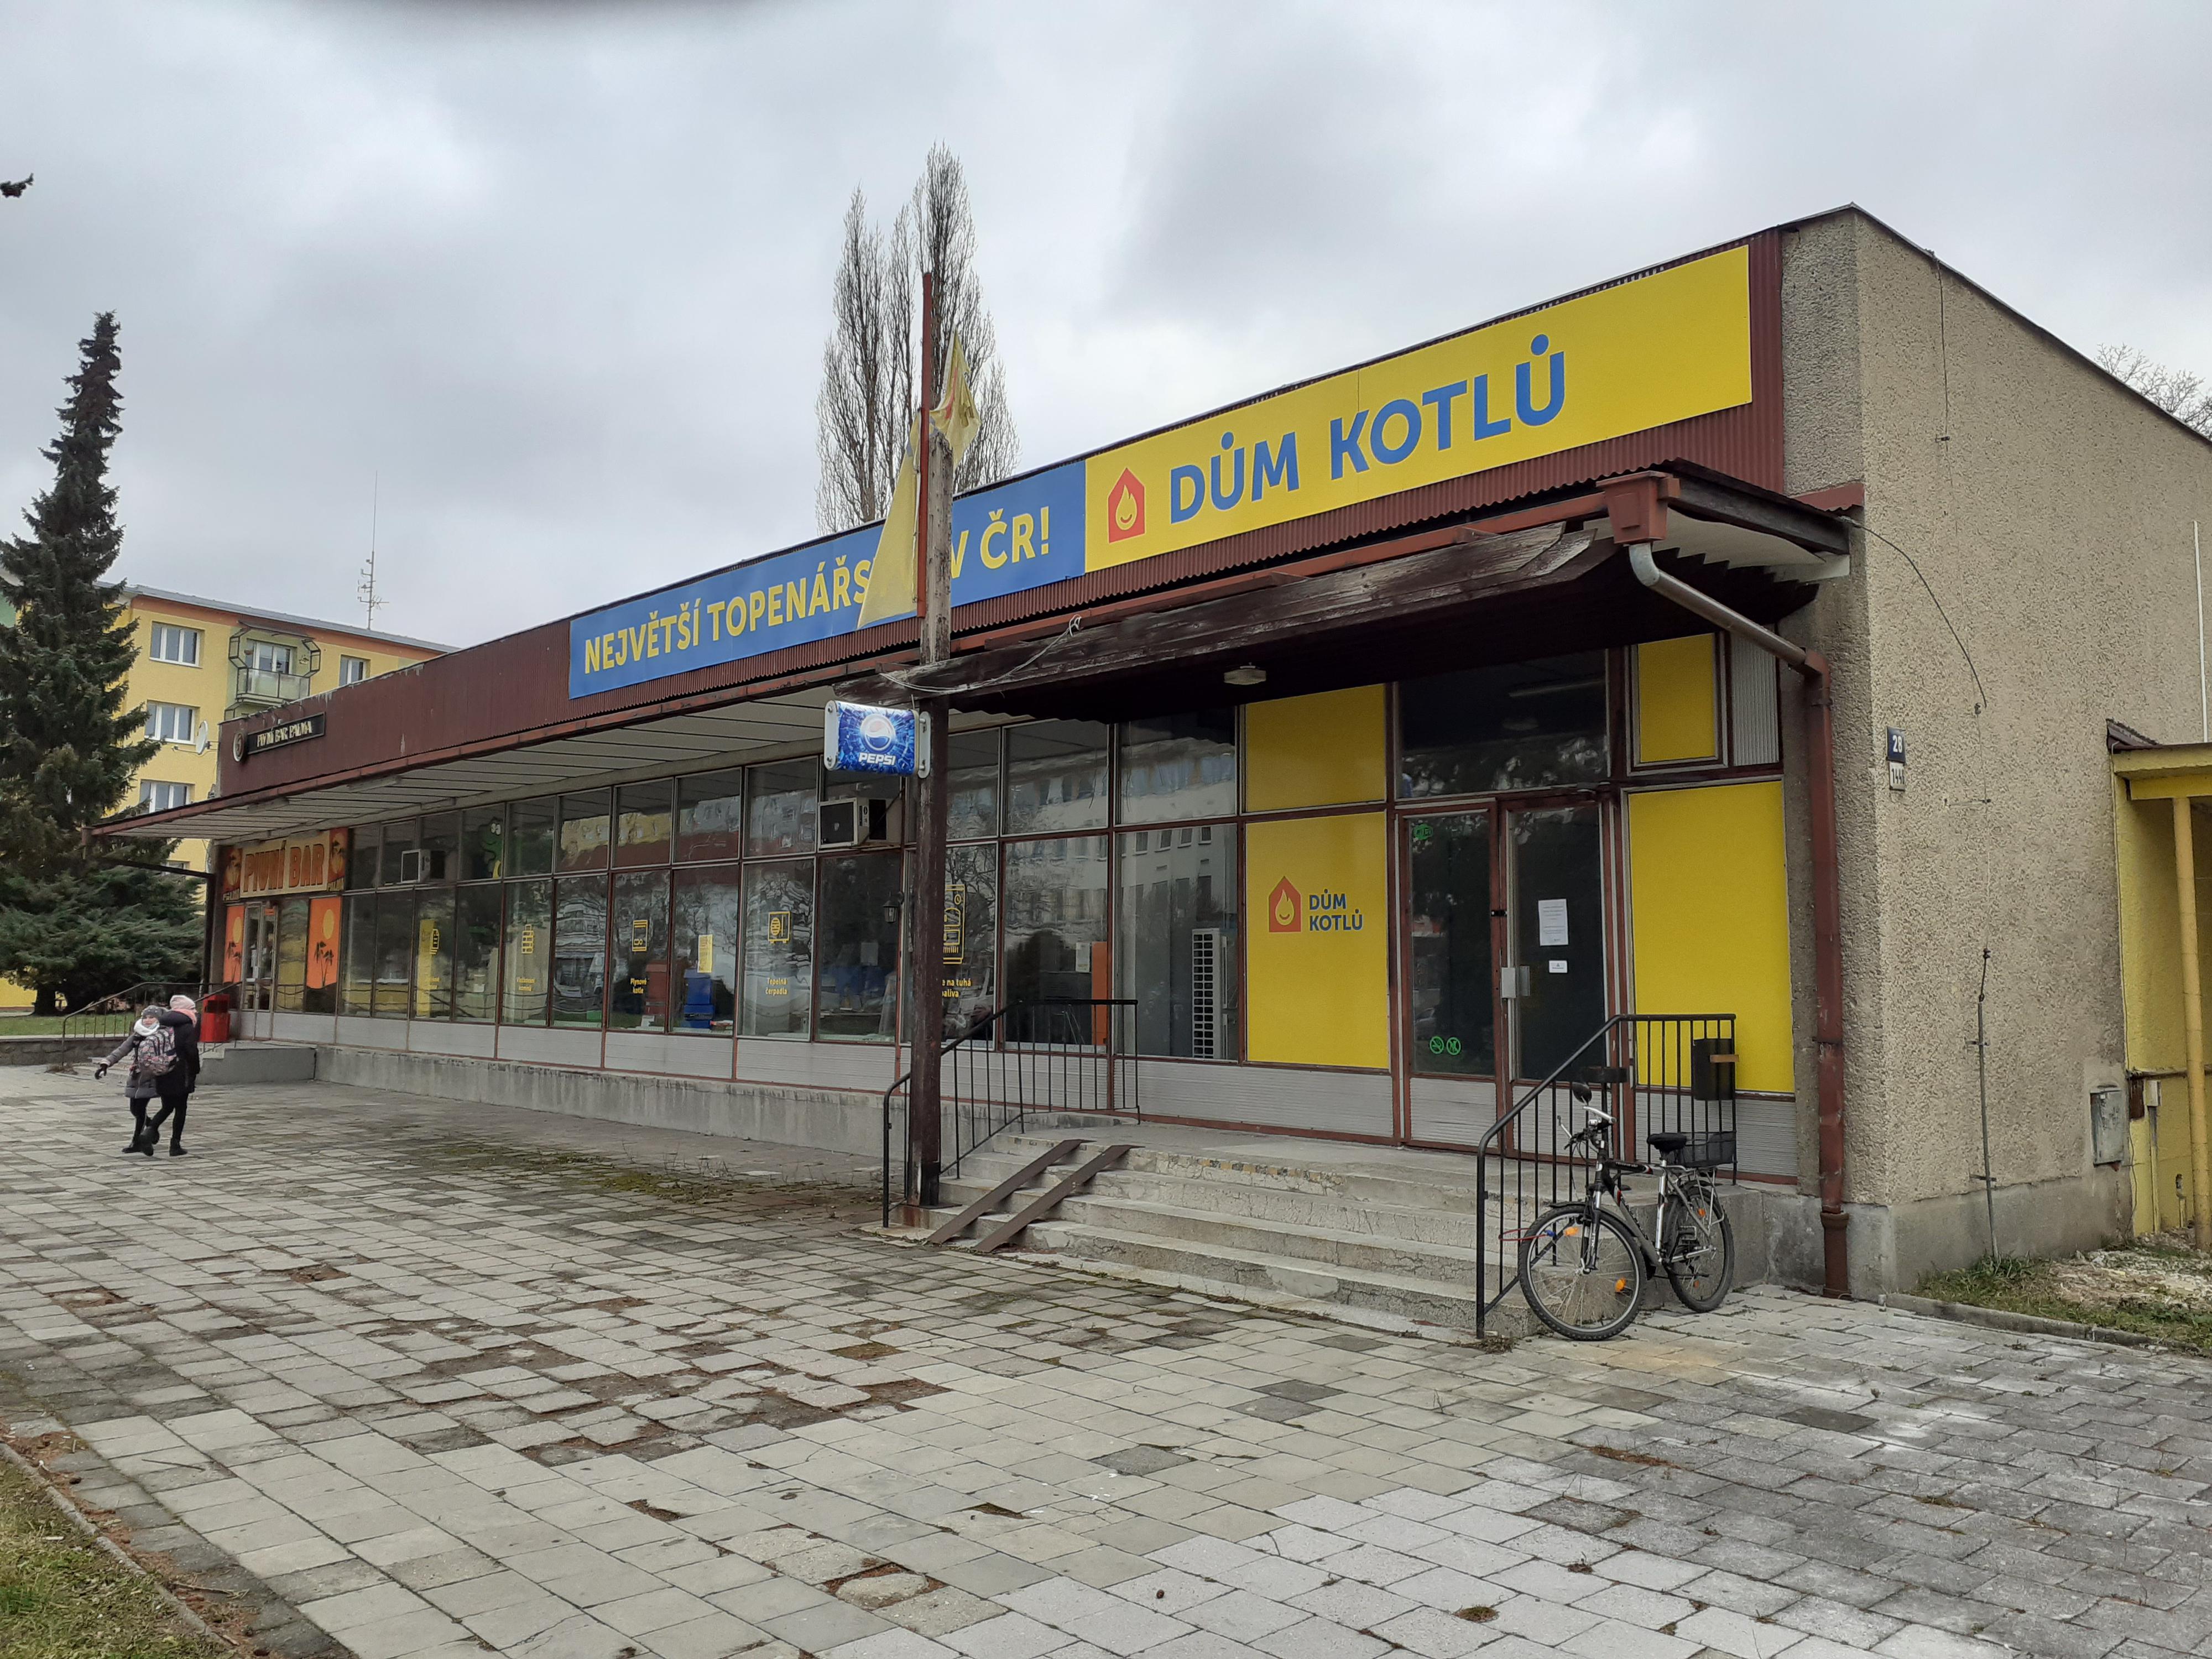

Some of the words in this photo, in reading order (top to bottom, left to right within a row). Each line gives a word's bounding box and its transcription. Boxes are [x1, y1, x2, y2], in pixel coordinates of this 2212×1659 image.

[1170, 431, 1300, 525] DŮM
[1329, 333, 1566, 481] KOTLŮ
[585, 597, 701, 674] NEJVĚTŠÍ
[707, 555, 872, 641] TOPENÁŘS
[980, 506, 1049, 570] ČR!
[275, 727, 288, 743] BAR
[289, 721, 312, 739] PALMA
[1892, 734, 1903, 753] 28
[858, 752, 896, 766] PEPSI
[243, 840, 286, 893] PIVNÍ
[289, 843, 325, 888] BAR
[1309, 888, 1347, 910] DŮM
[1309, 909, 1363, 931] KOTLŮ
[956, 978, 972, 986] tuhá
